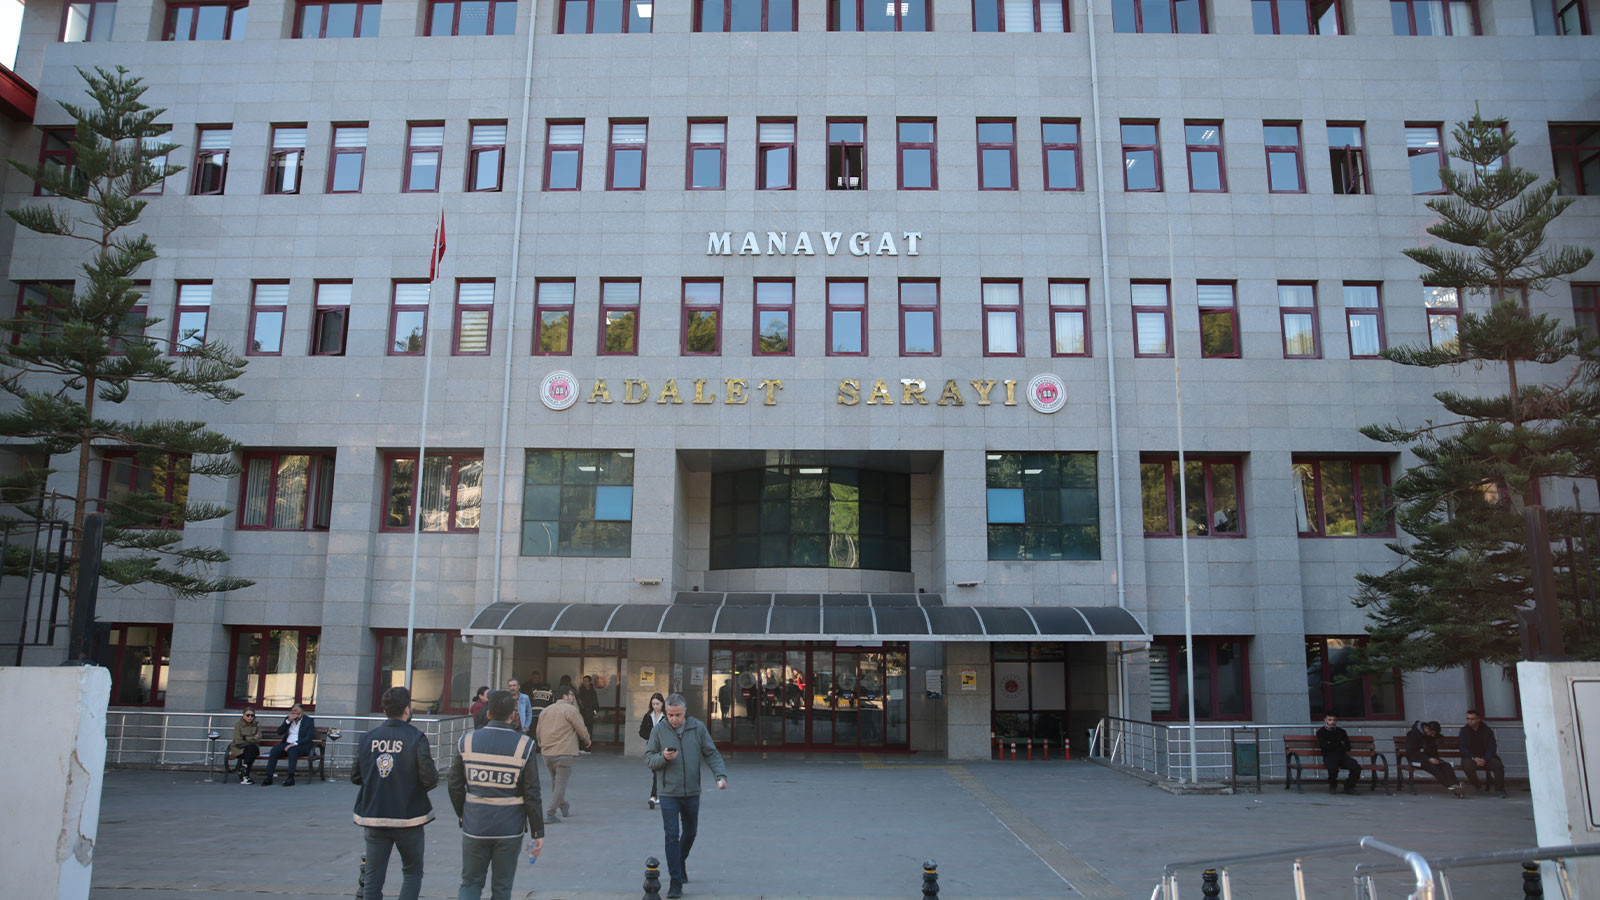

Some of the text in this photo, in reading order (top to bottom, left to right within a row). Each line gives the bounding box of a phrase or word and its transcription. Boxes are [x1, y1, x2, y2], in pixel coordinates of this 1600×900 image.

[707, 231, 922, 256] MANAVGAT
[587, 378, 1018, 406] ADALET SARAYI
[371, 740, 403, 753] POLIS
